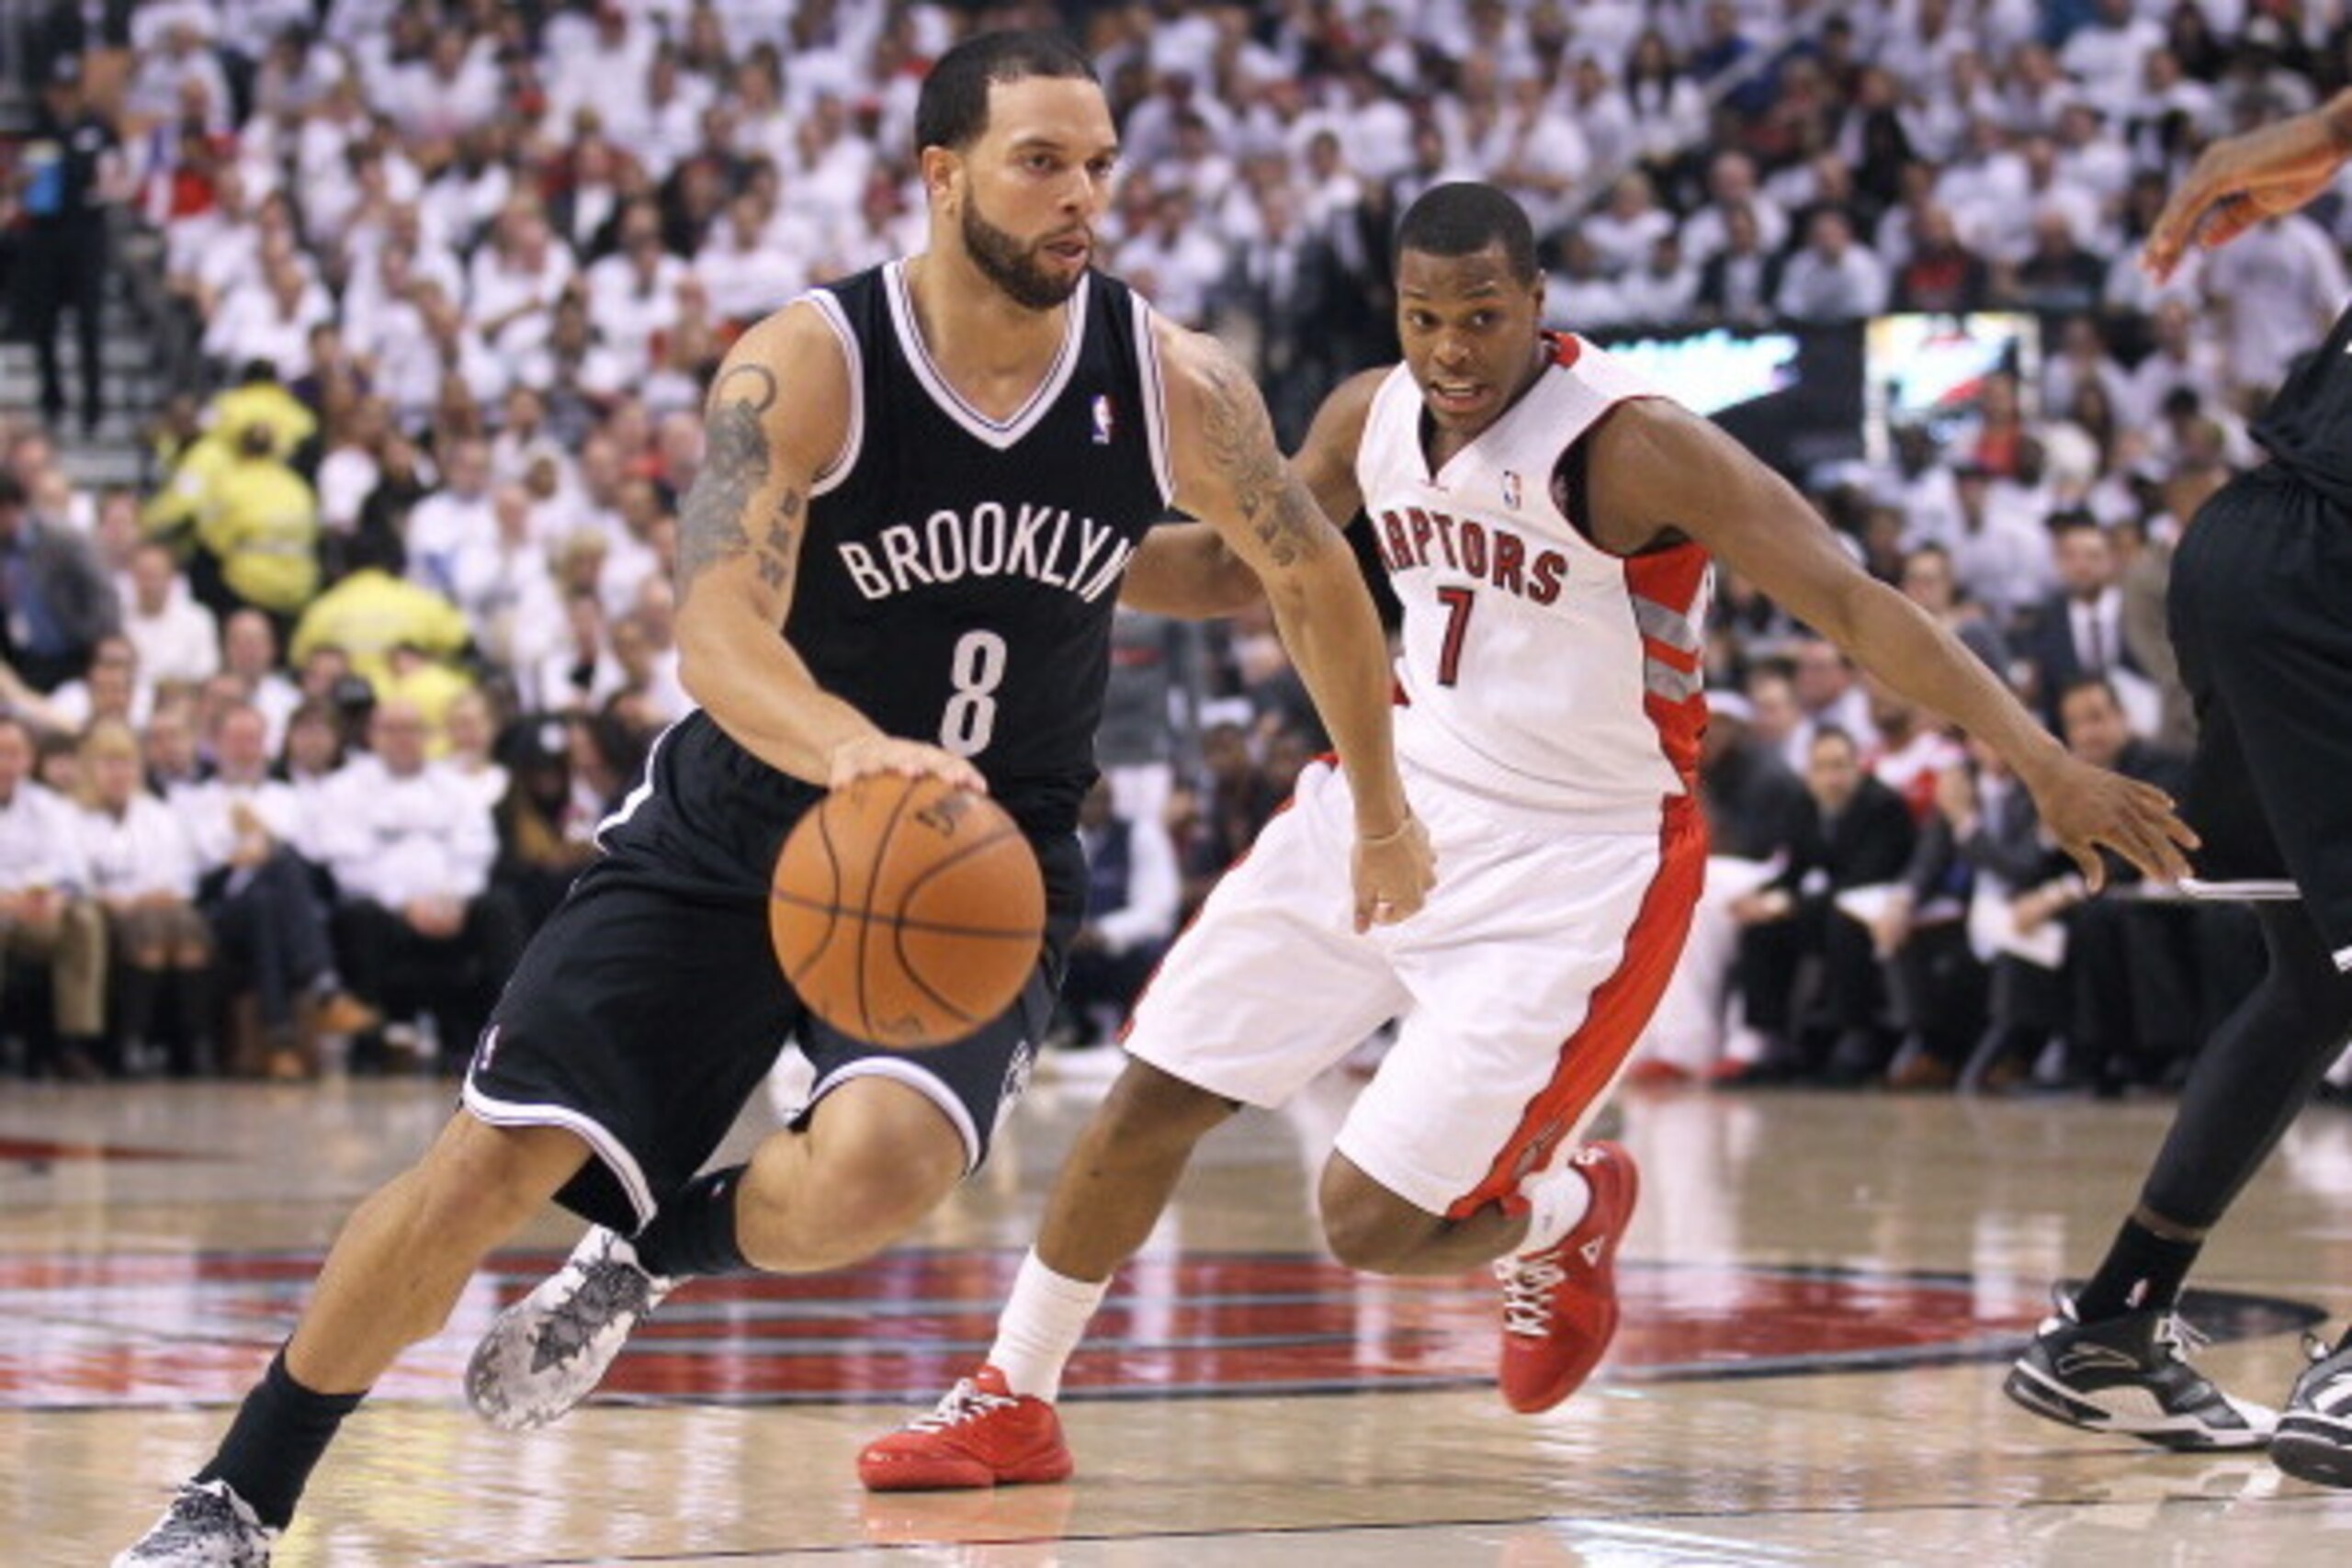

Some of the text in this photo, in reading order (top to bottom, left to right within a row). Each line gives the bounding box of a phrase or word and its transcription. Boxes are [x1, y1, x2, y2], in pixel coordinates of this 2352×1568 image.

[1376, 507, 1568, 606] APTORS
[1435, 584, 1475, 689] 7
[938, 629, 1008, 758] 8
